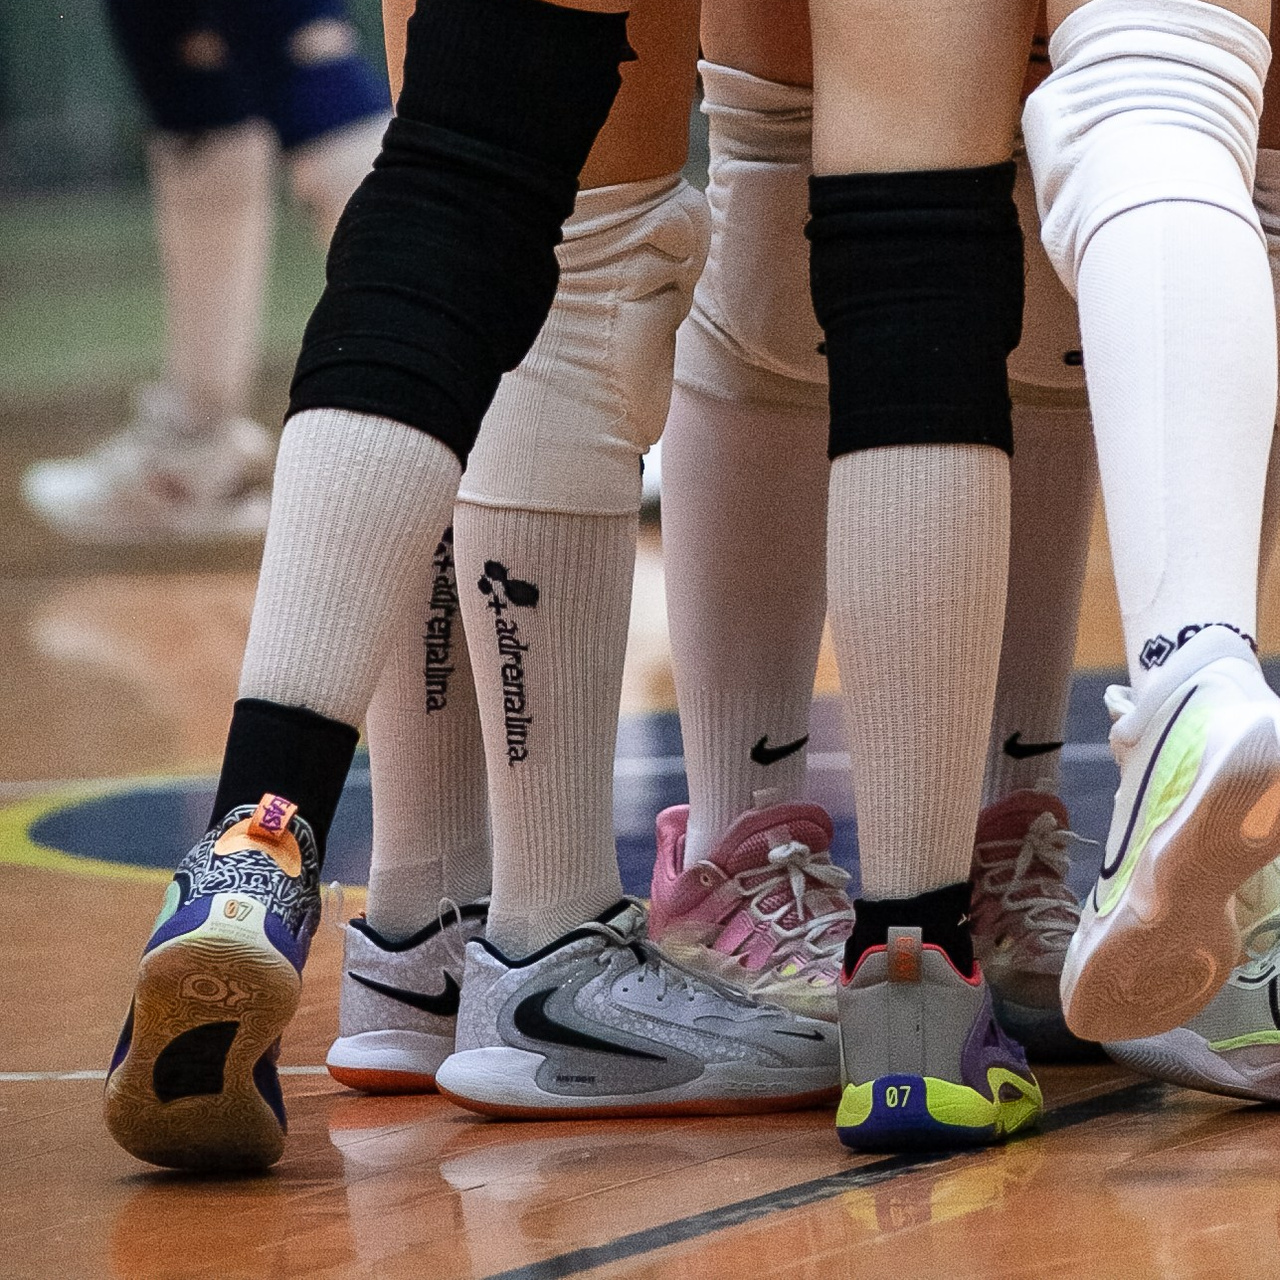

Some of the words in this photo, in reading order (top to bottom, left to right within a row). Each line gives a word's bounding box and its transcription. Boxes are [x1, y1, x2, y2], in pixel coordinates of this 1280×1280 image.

[495, 618, 533, 767] adrenalina
[223, 899, 254, 922] 07
[885, 1085, 912, 1108] 07
